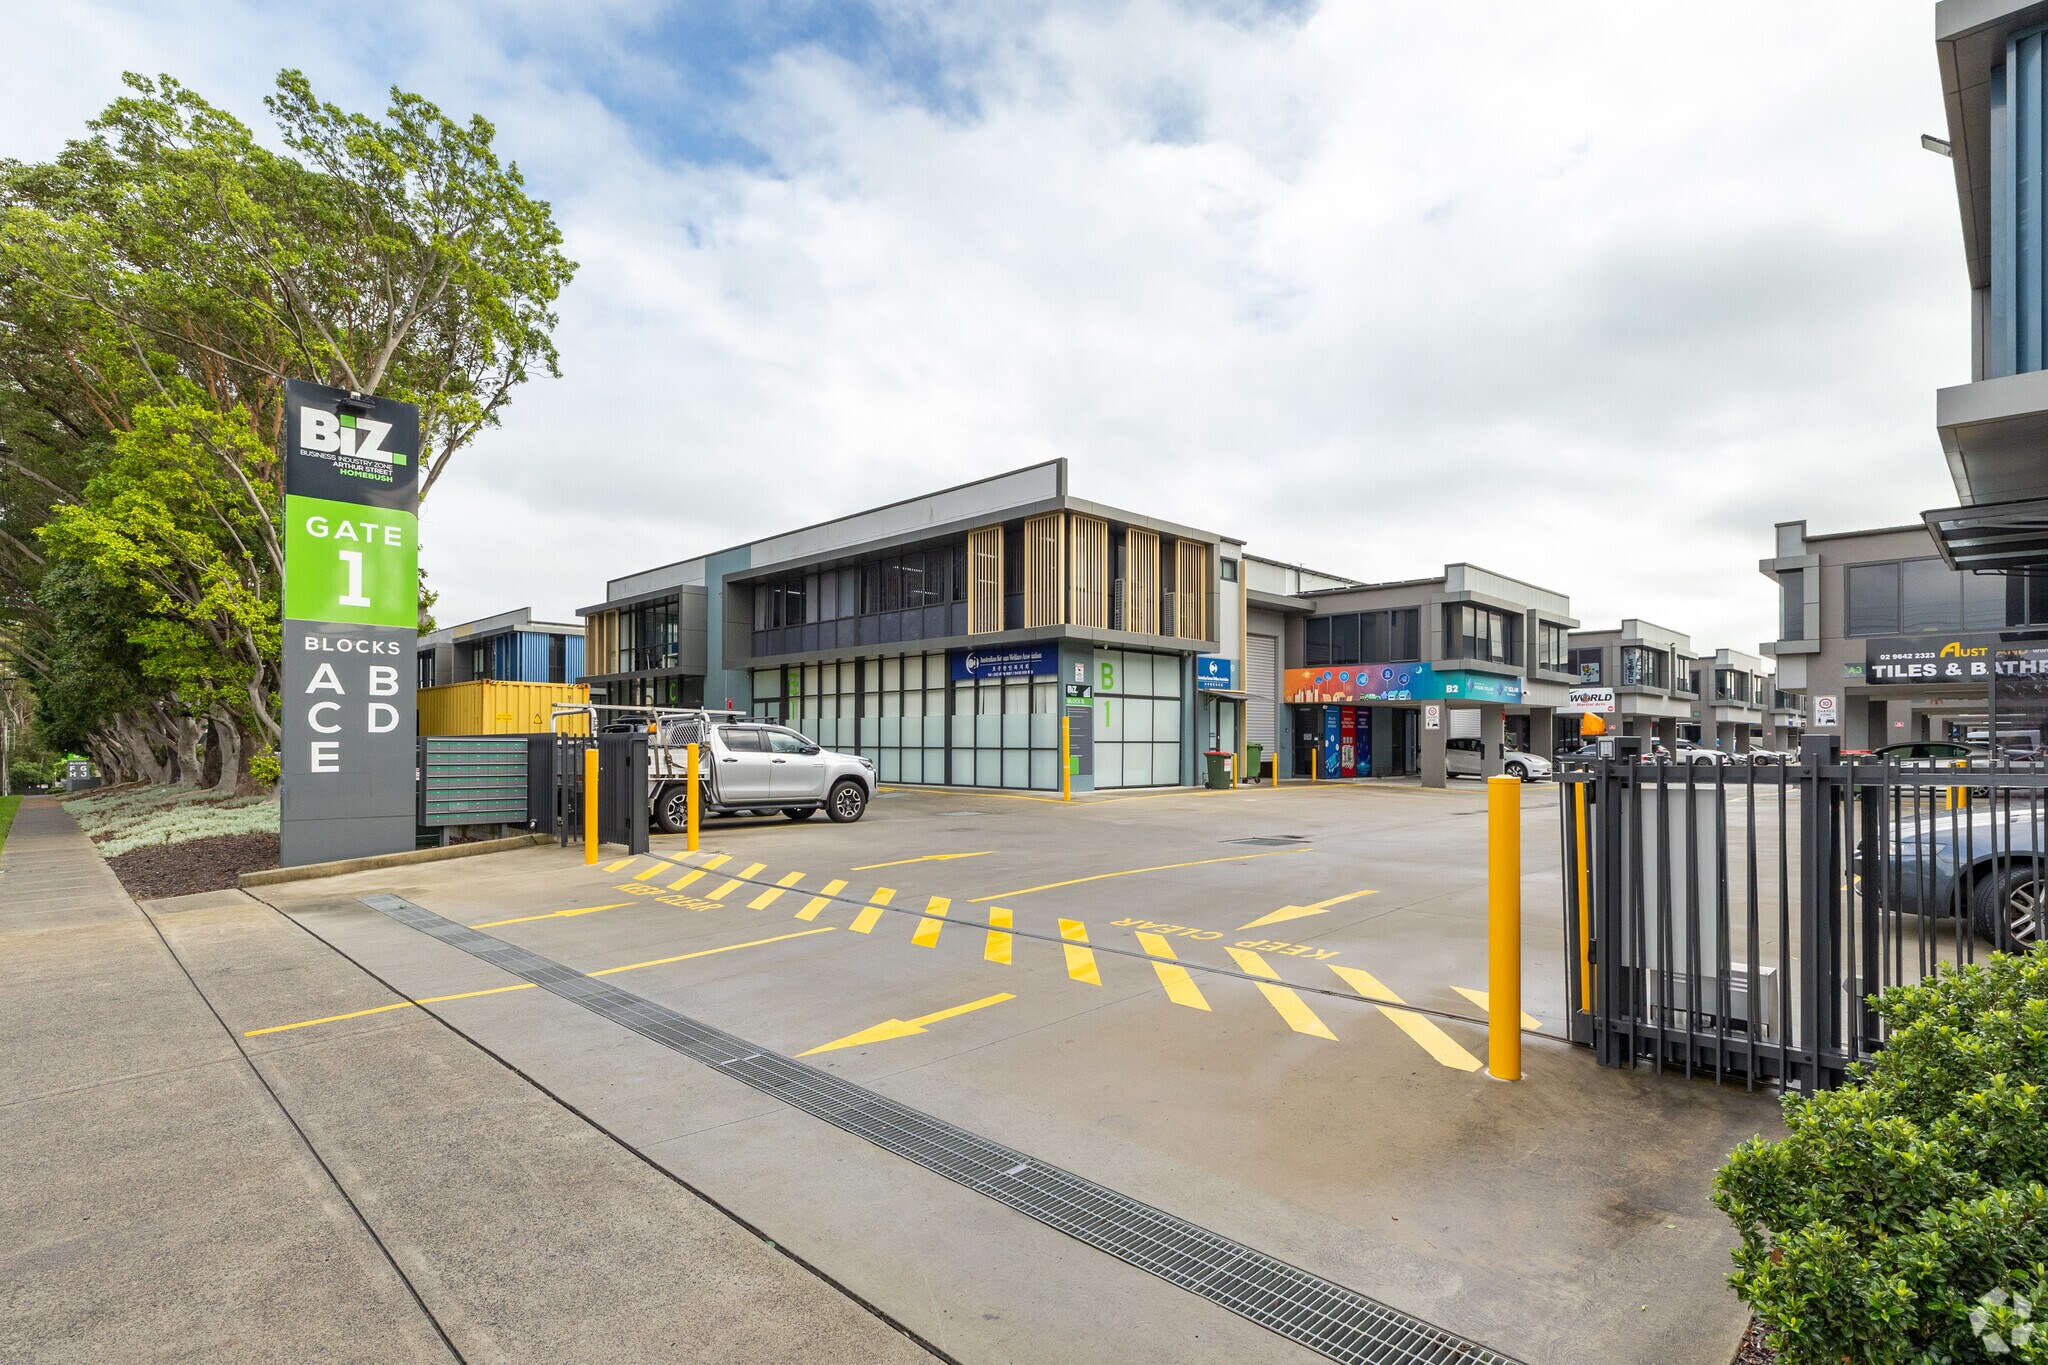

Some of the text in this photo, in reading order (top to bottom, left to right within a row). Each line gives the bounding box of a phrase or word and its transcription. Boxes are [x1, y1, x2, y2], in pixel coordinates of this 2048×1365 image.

[300, 449, 393, 471] BUSINESS INDUSTRY ZONE
[332, 461, 393, 476] ARTHUR STREET
[340, 468, 393, 483] HOMEBUSH
[306, 516, 402, 547] GATE
[339, 550, 371, 608] 1
[304, 636, 400, 655] BLOCKS
[305, 662, 399, 696] A B
[1101, 662, 1114, 690] B
[1848, 666, 1863, 674] A3
[1872, 663, 1937, 678] TILES
[1945, 662, 1963, 676] &
[670, 682, 676, 702] C
[1446, 684, 1459, 693] B2
[1570, 693, 1612, 703] WORLD
[308, 701, 399, 734] C D
[1104, 700, 1111, 728] 1
[311, 741, 340, 773] E
[1110, 917, 1224, 940] CLEAR
[1234, 939, 1340, 961] KEEP
